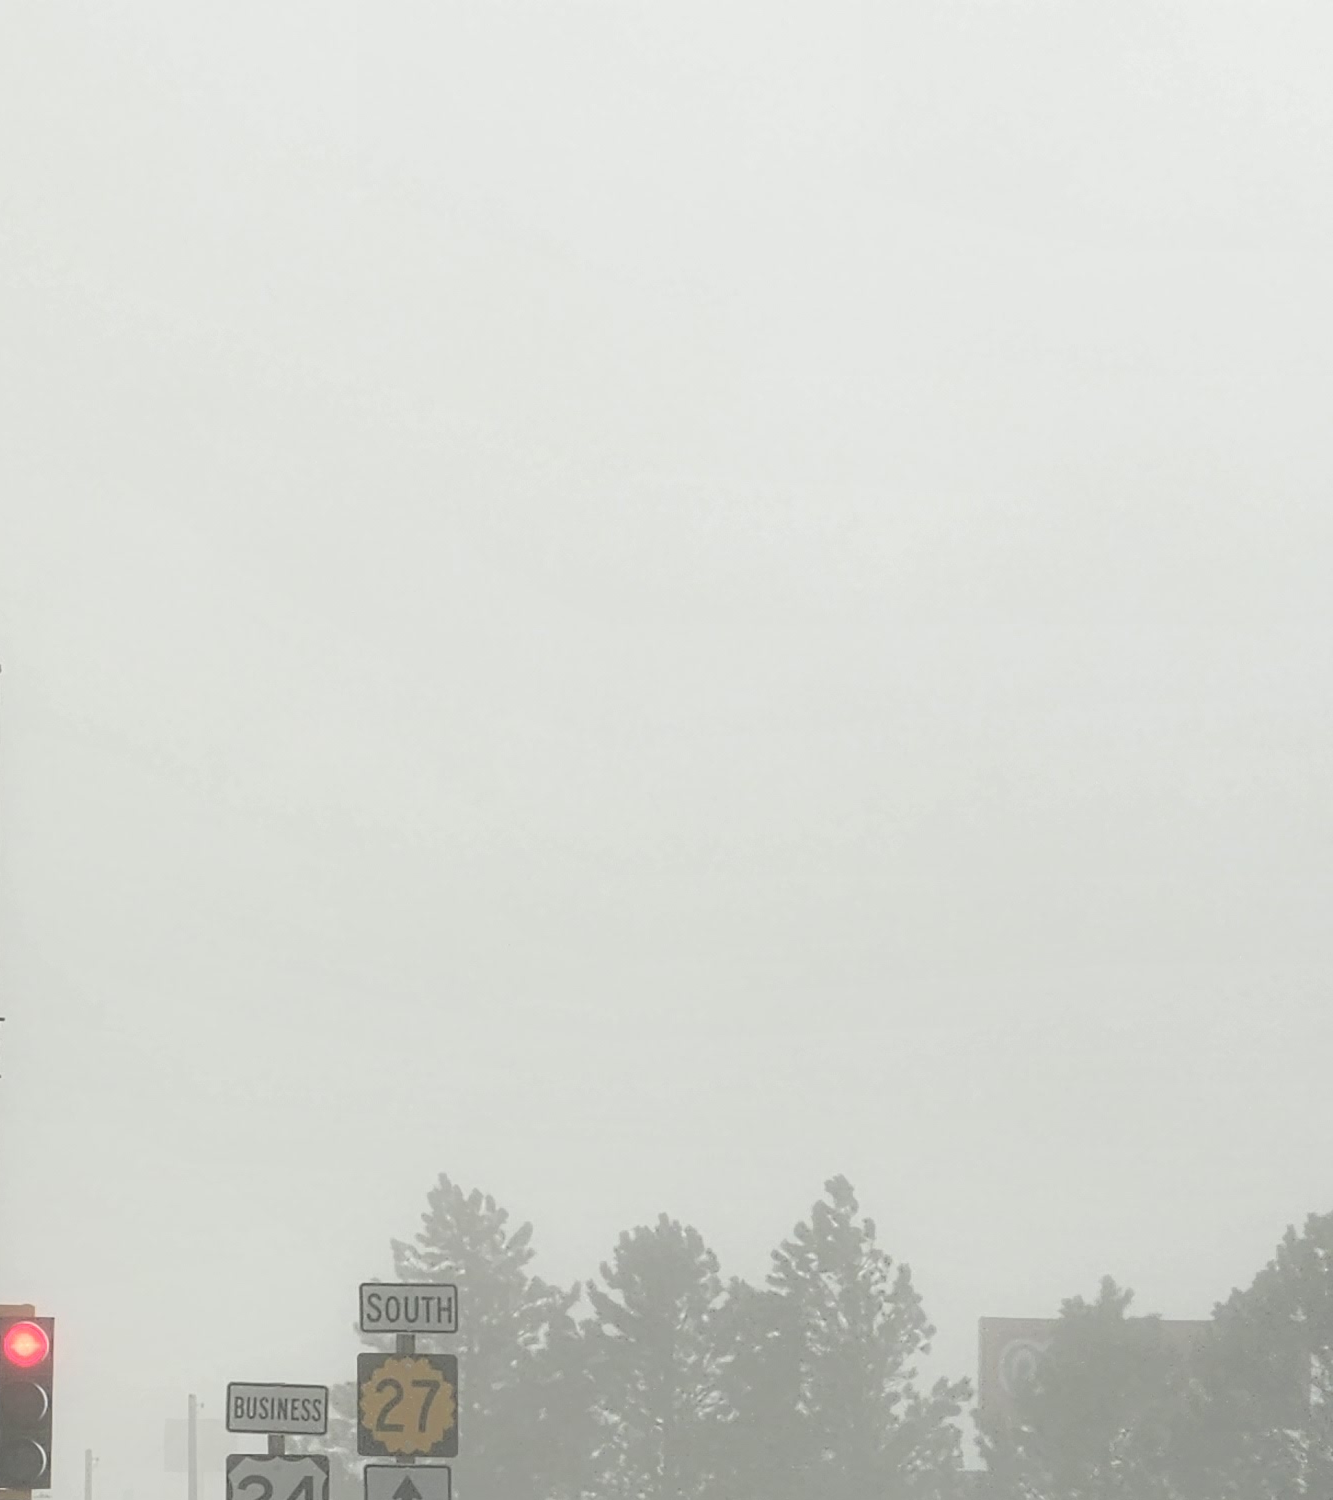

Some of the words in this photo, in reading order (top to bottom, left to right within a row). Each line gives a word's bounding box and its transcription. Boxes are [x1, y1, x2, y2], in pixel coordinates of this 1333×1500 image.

[366, 1293, 452, 1324] SOUTH
[234, 1396, 322, 1421] BUSINESS
[375, 1378, 441, 1433] 27
